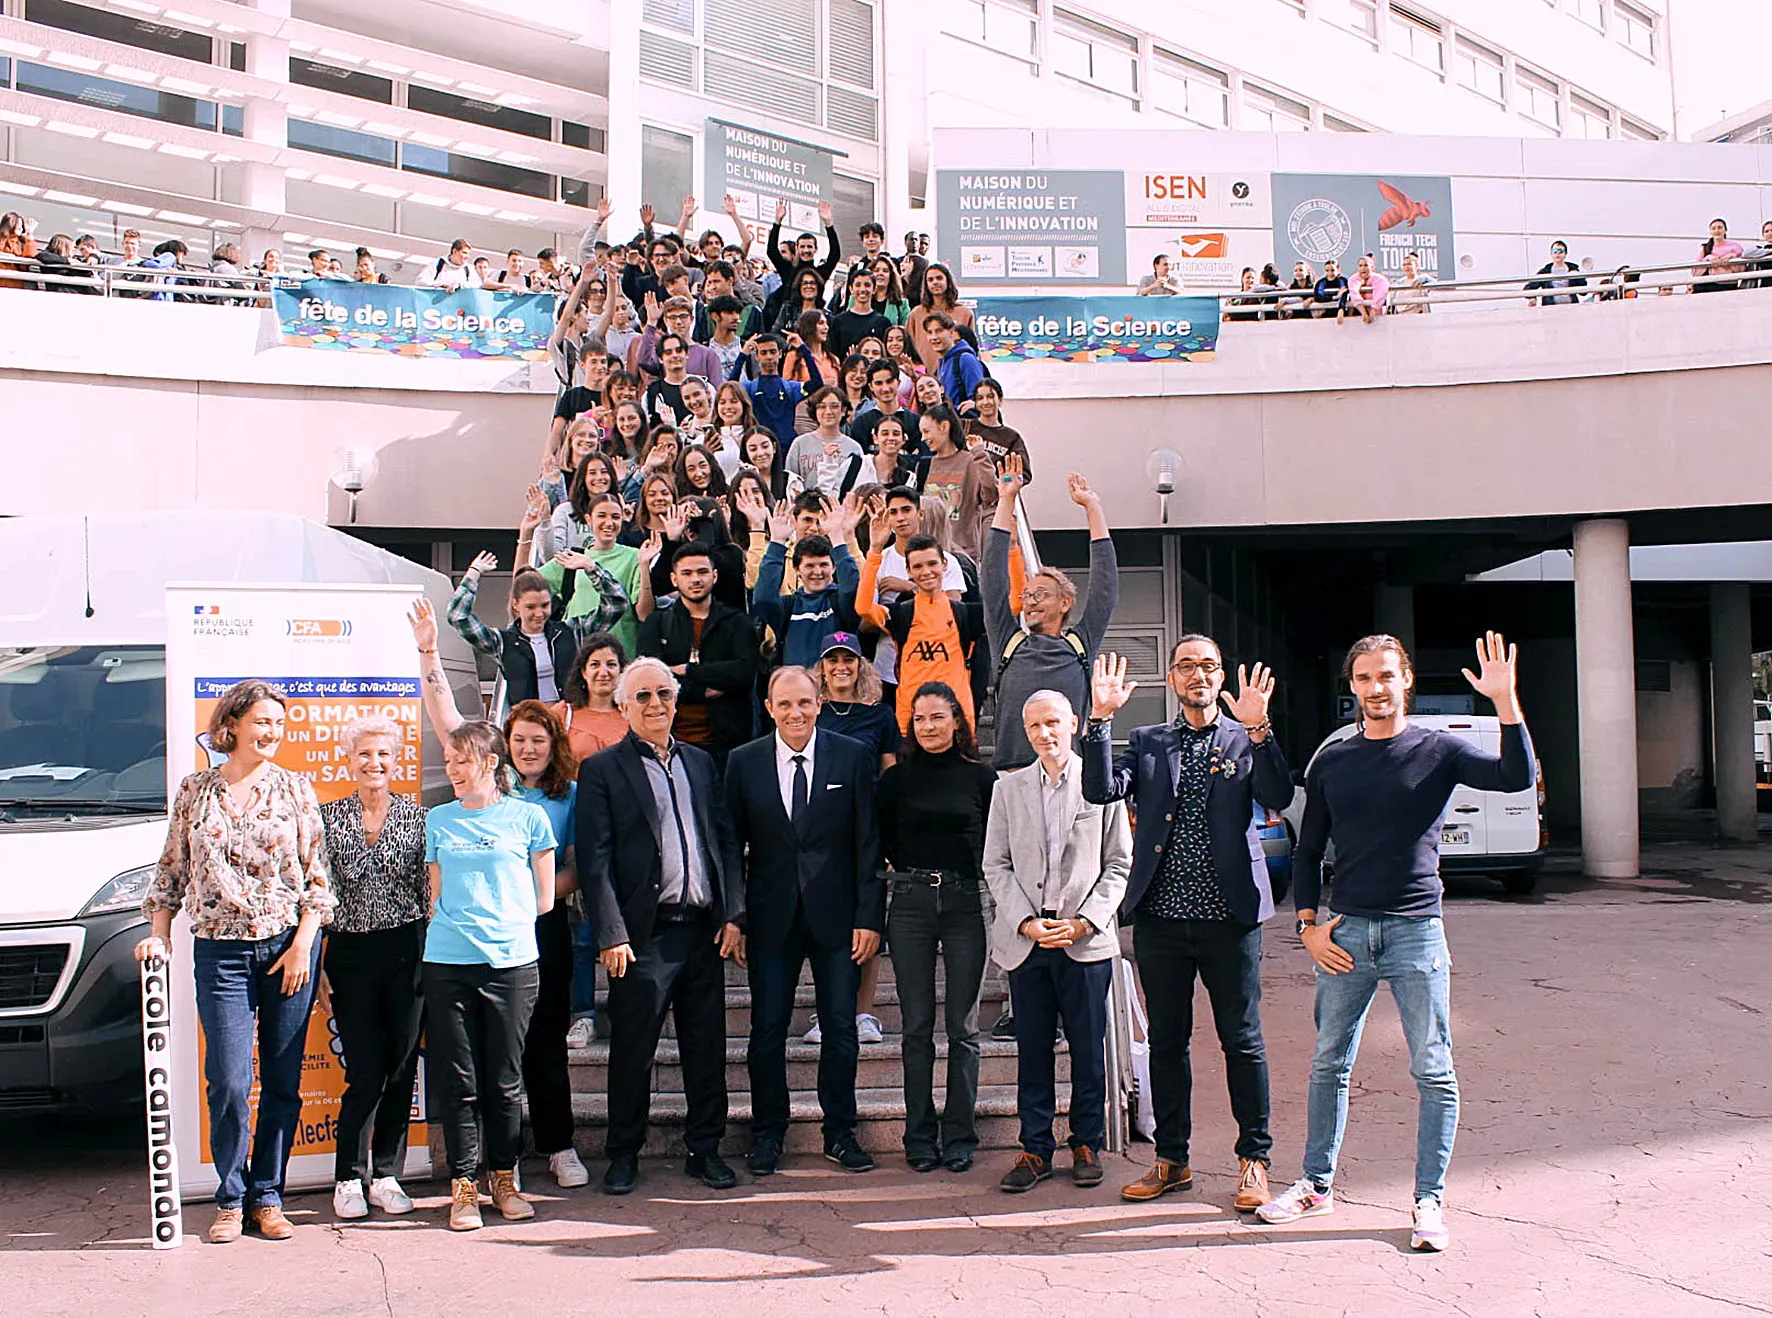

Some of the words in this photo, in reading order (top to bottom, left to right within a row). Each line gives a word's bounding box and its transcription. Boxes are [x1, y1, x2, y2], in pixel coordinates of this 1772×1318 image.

[725, 127, 769, 149] MAISON
[772, 141, 787, 154] DU
[725, 145, 791, 170] NUMÉRIQUE
[793, 163, 807, 176] ET
[726, 162, 741, 177] DE
[744, 167, 820, 195] L'INNOVATION
[959, 176, 1021, 190] MAISON
[1026, 176, 1048, 190] DU
[1145, 175, 1207, 199] ISEN
[960, 193, 1055, 210] NUMÉRIQUE
[1059, 196, 1078, 210] ET
[960, 217, 981, 231] DE
[986, 216, 1098, 231] L'INNOVATION
[747, 224, 770, 244] SE
[1379, 234, 1413, 247] FRENCH
[1415, 234, 1437, 247] TECH
[1380, 248, 1438, 270] TOUON
[298, 297, 348, 323] fête
[354, 304, 389, 327] de
[395, 306, 417, 329] la
[422, 308, 525, 334] Science
[976, 314, 1022, 337] fête
[1028, 315, 1060, 337] de
[1066, 316, 1088, 336] la
[1092, 315, 1192, 337] Science
[293, 621, 323, 635] CFA
[906, 641, 949, 662] AXA
[289, 682, 314, 693] c'est
[316, 684, 338, 697] que
[339, 682, 357, 692] des
[360, 682, 416, 696] avantages
[288, 704, 417, 722] ORMATION
[1339, 698, 1355, 716] P
[287, 731, 310, 742] UN
[306, 751, 329, 762] UN
[301, 1061, 331, 1070] CILITE
[300, 1090, 326, 1098] enaires
[149, 1067, 179, 1243] camondo
